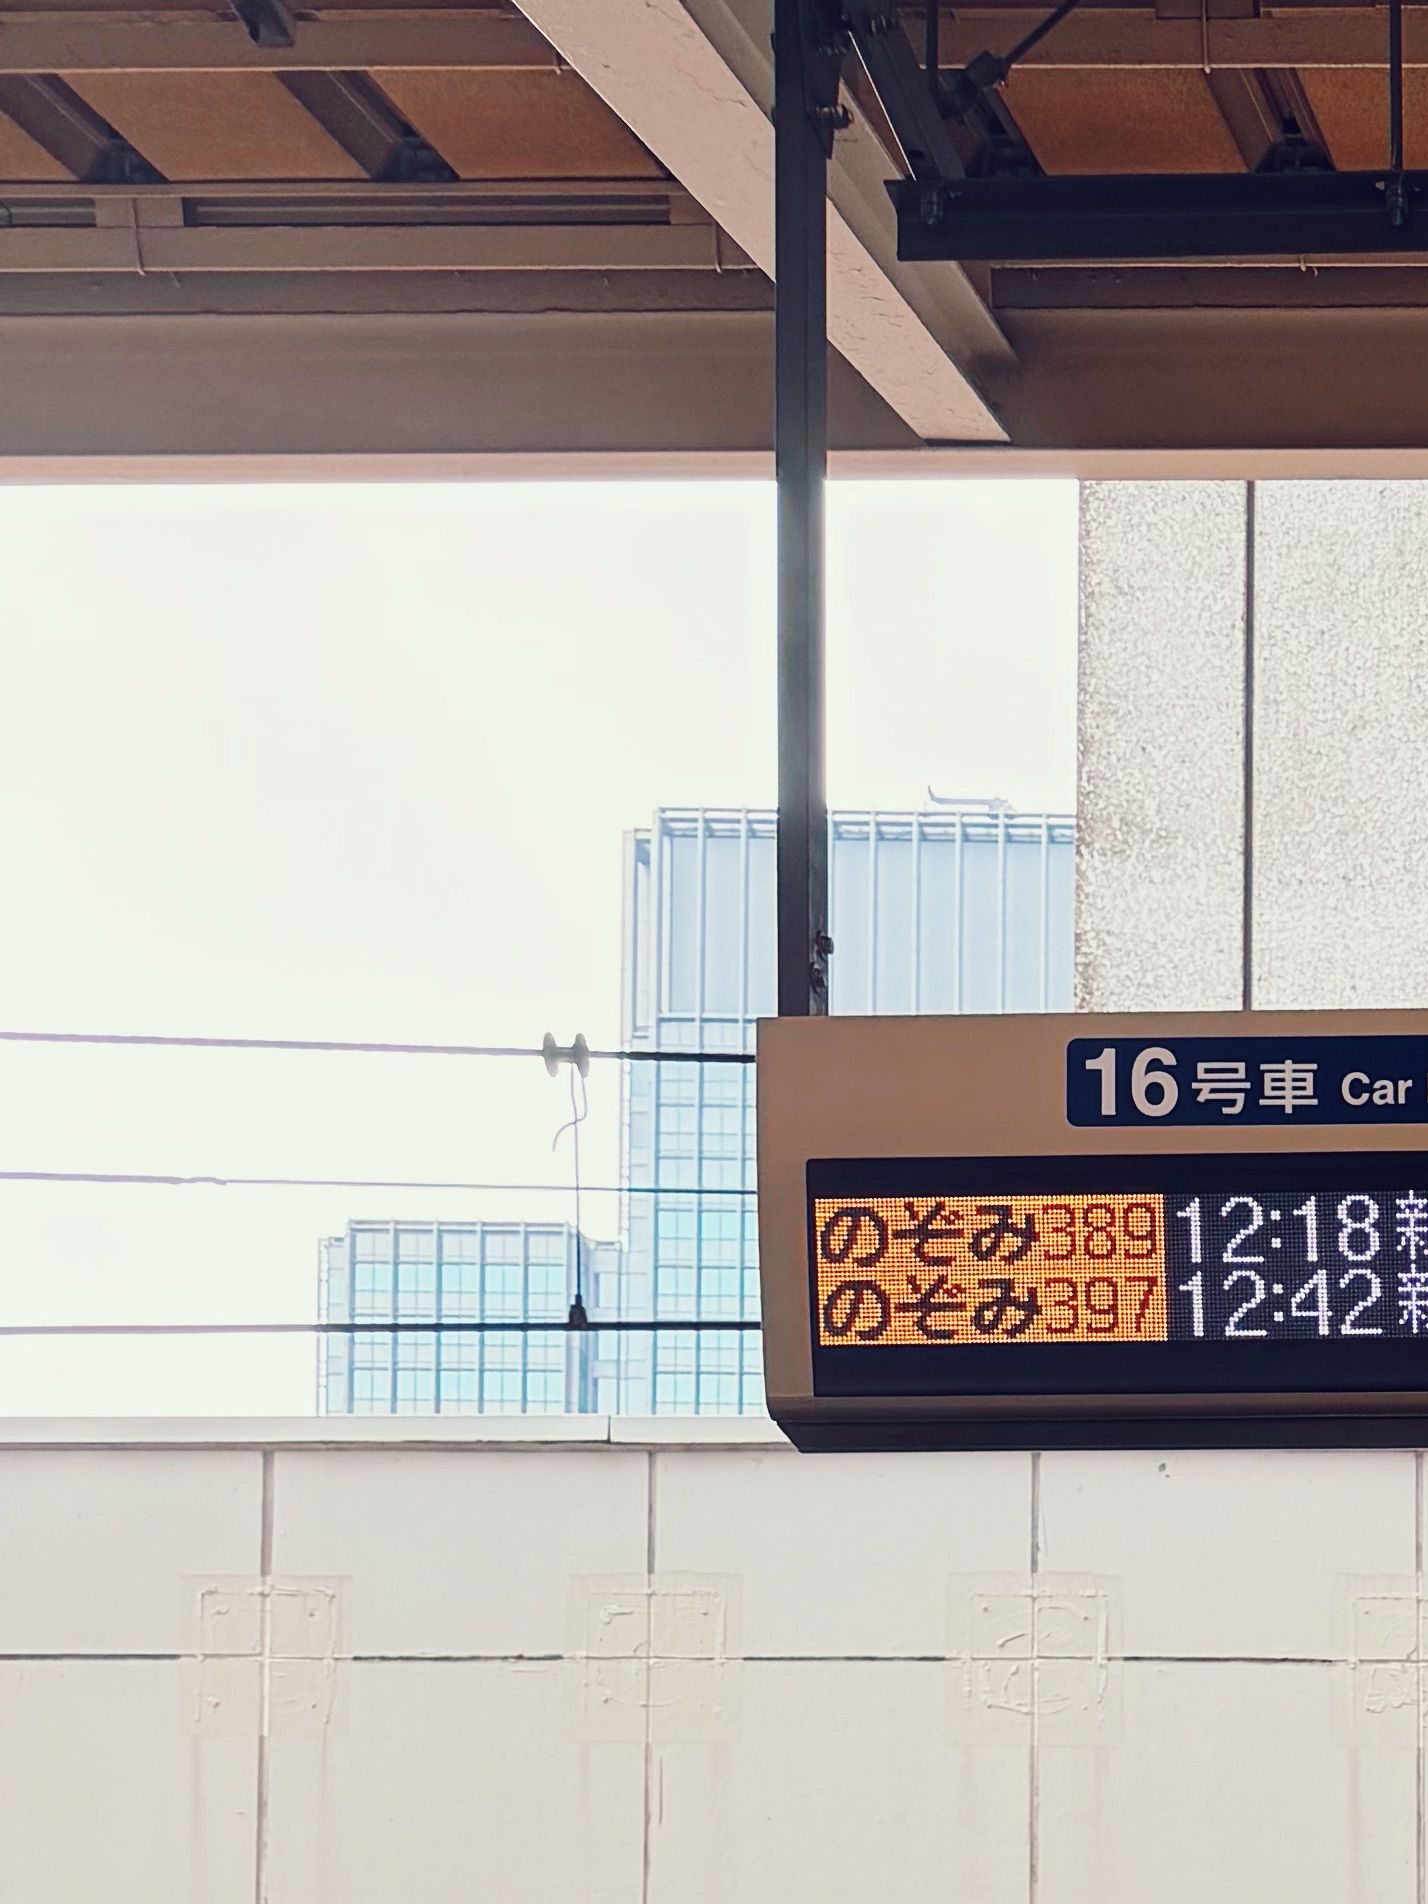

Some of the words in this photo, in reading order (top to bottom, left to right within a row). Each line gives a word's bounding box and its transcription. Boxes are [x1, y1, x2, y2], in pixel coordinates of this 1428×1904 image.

[1082, 1046, 1318, 1117] 16号車
[1341, 1072, 1411, 1107] Car
[1177, 1194, 1382, 1266] 12:18
[1177, 1268, 1384, 1340] 12:42
